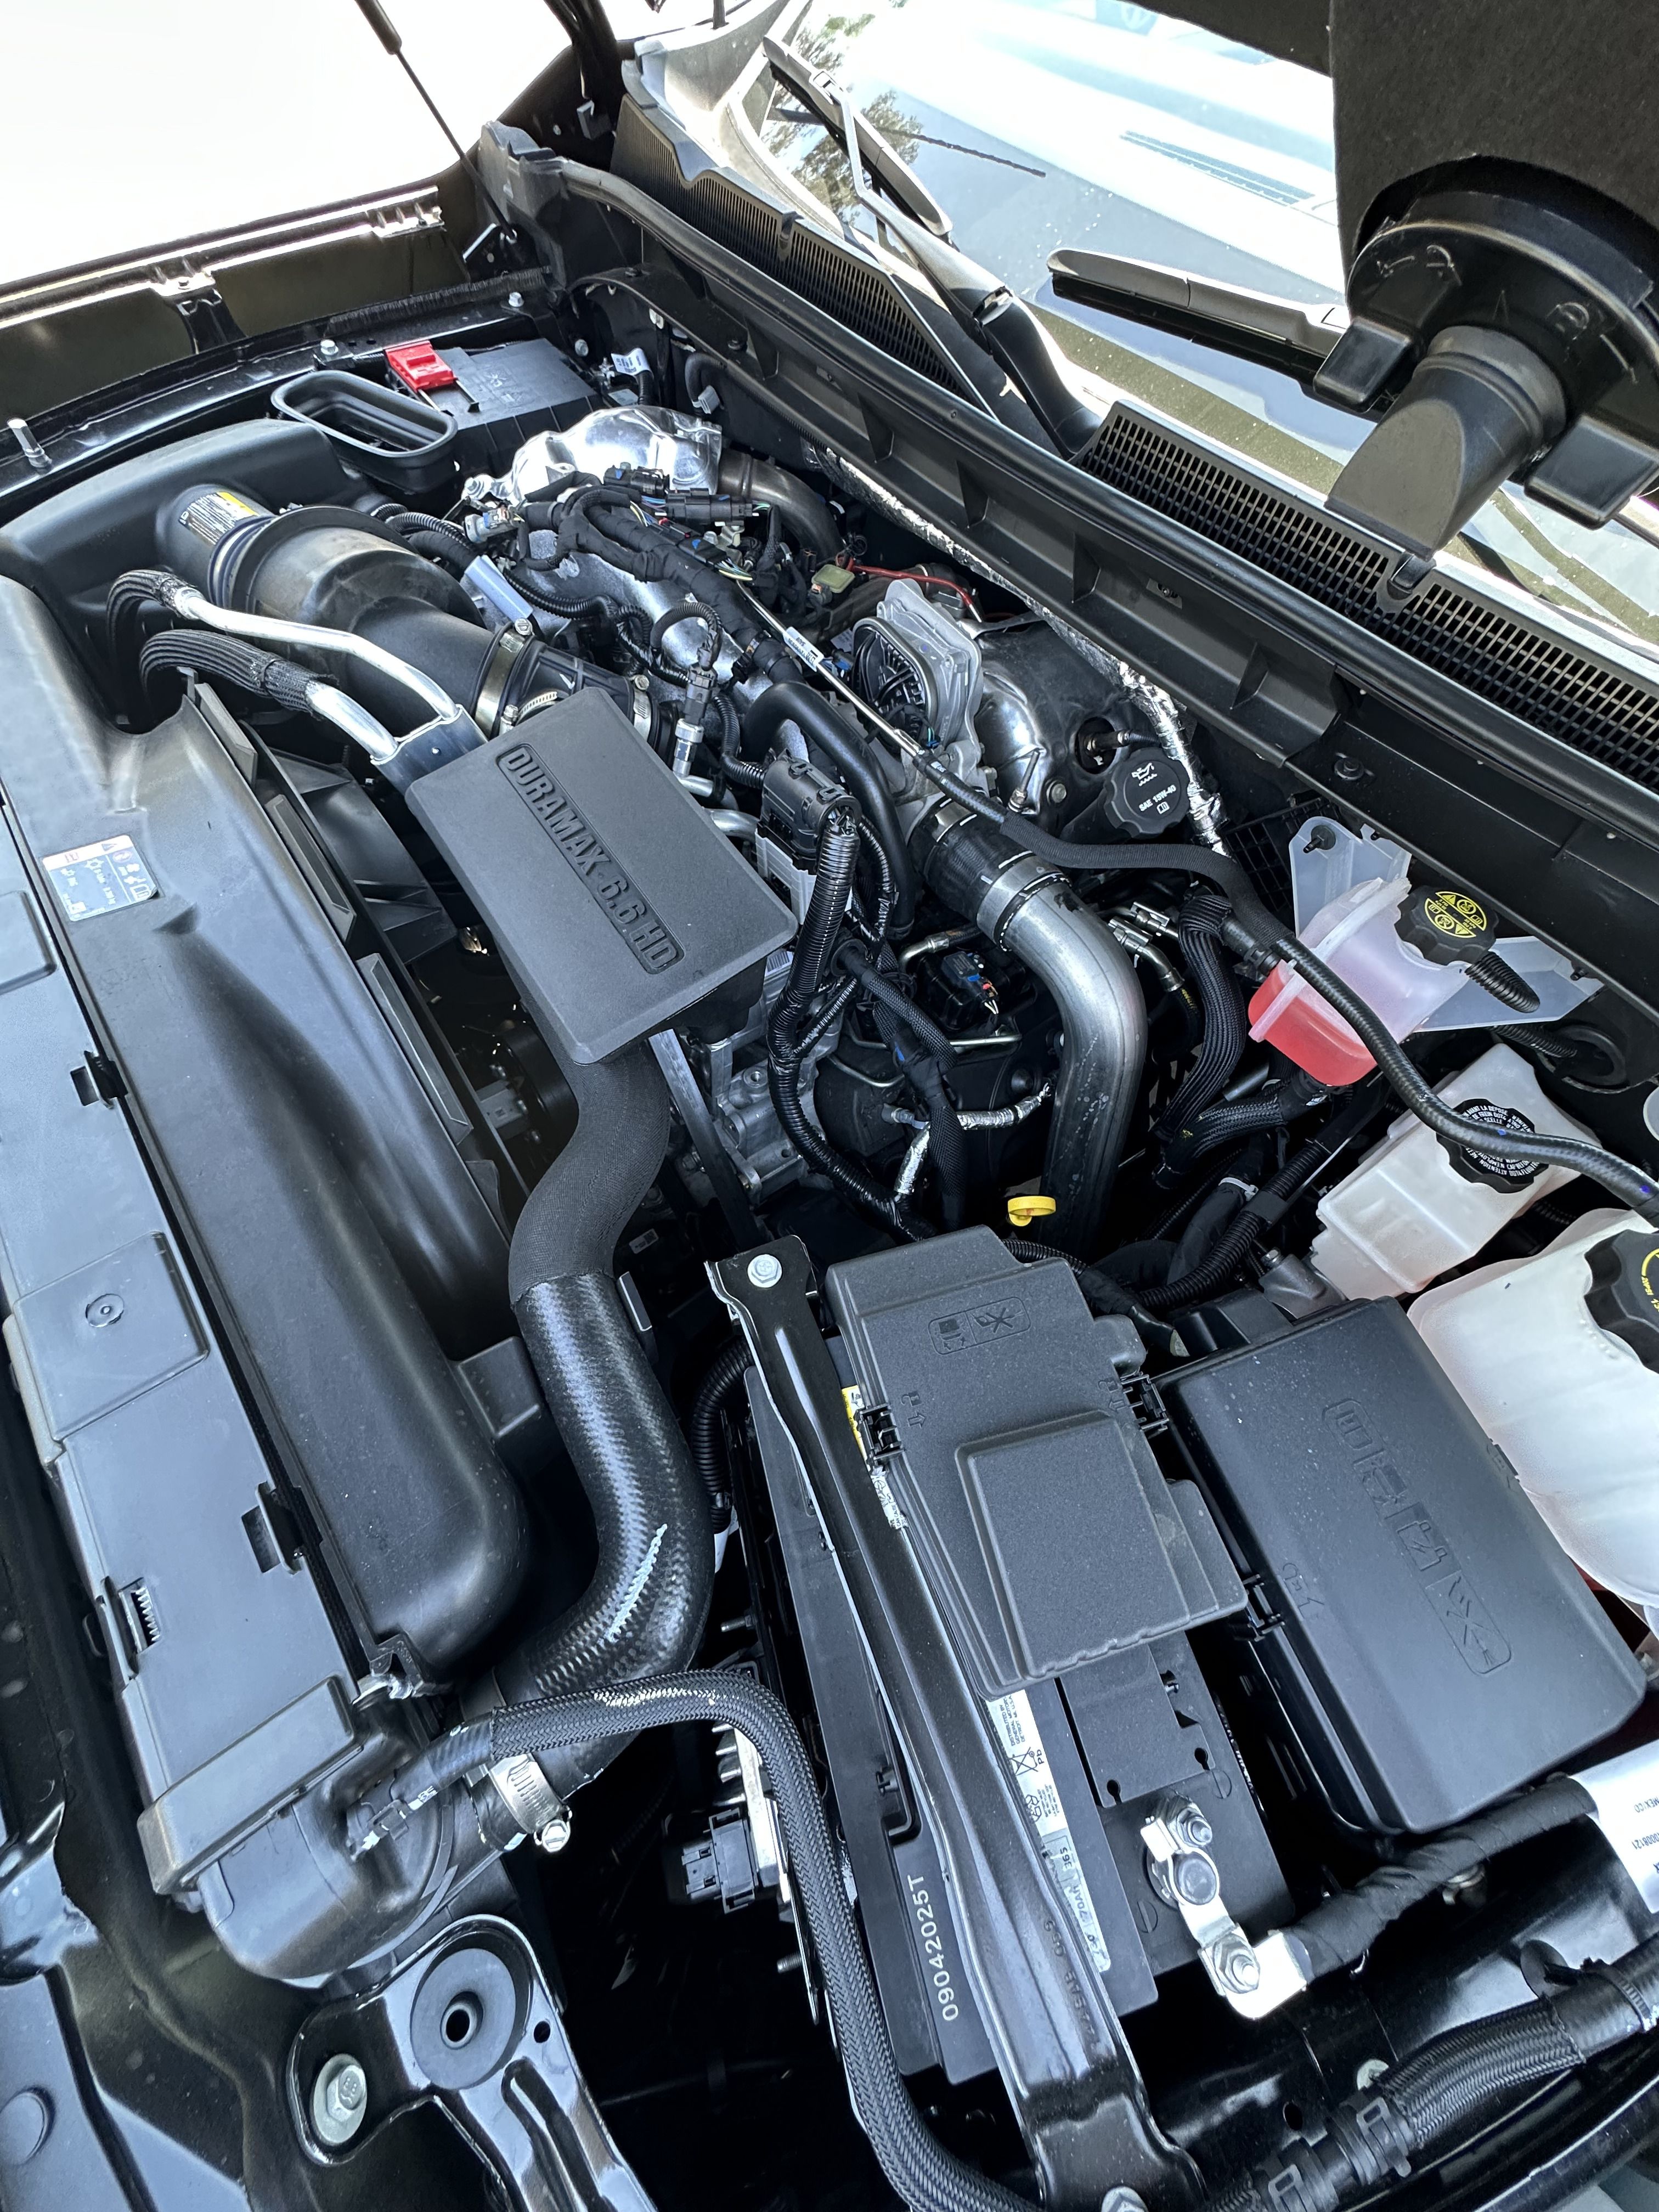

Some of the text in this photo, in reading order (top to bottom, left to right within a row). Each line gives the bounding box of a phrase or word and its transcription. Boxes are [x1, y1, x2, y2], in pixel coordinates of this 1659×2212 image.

[1139, 785, 1176, 812] SAE 15W-40
[505, 747, 679, 969] DURAMAX 6.6 HD
[1466, 1148, 1479, 1159] NETT
[1477, 1152, 1505, 1169] N'EMPLOYE
[1479, 1159, 1507, 1175] ATTENTION
[1002, 1711, 1015, 1746] DISTRIBUTED
[1009, 1720, 1020, 1744] GENERAL
[1015, 1719, 1025, 1742] DETROIT
[1036, 1749, 1045, 1765] Pb
[1634, 1796, 1659, 1813] MEXICO
[1632, 1832, 1659, 1849] 0008121
[1059, 1847, 1073, 1869] 365
[907, 1874, 959, 2022] 09042025T
